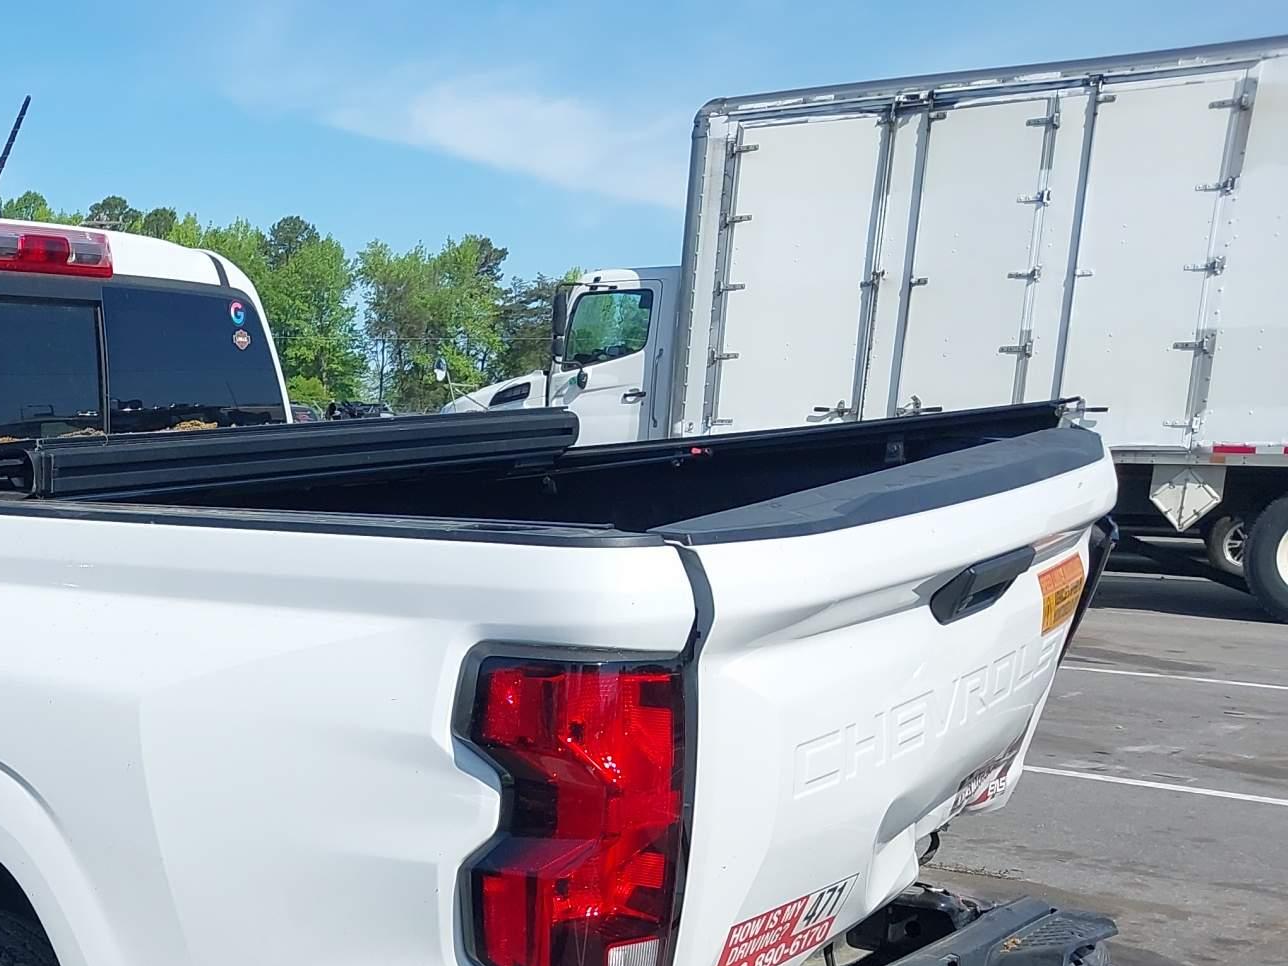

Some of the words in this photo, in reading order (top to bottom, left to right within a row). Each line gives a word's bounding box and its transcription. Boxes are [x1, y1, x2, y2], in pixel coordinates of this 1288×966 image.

[729, 919, 764, 948] HOW
[766, 908, 781, 930] IS
[781, 898, 805, 924] MY
[803, 881, 848, 928] 471
[725, 923, 791, 966] DRIVING?
